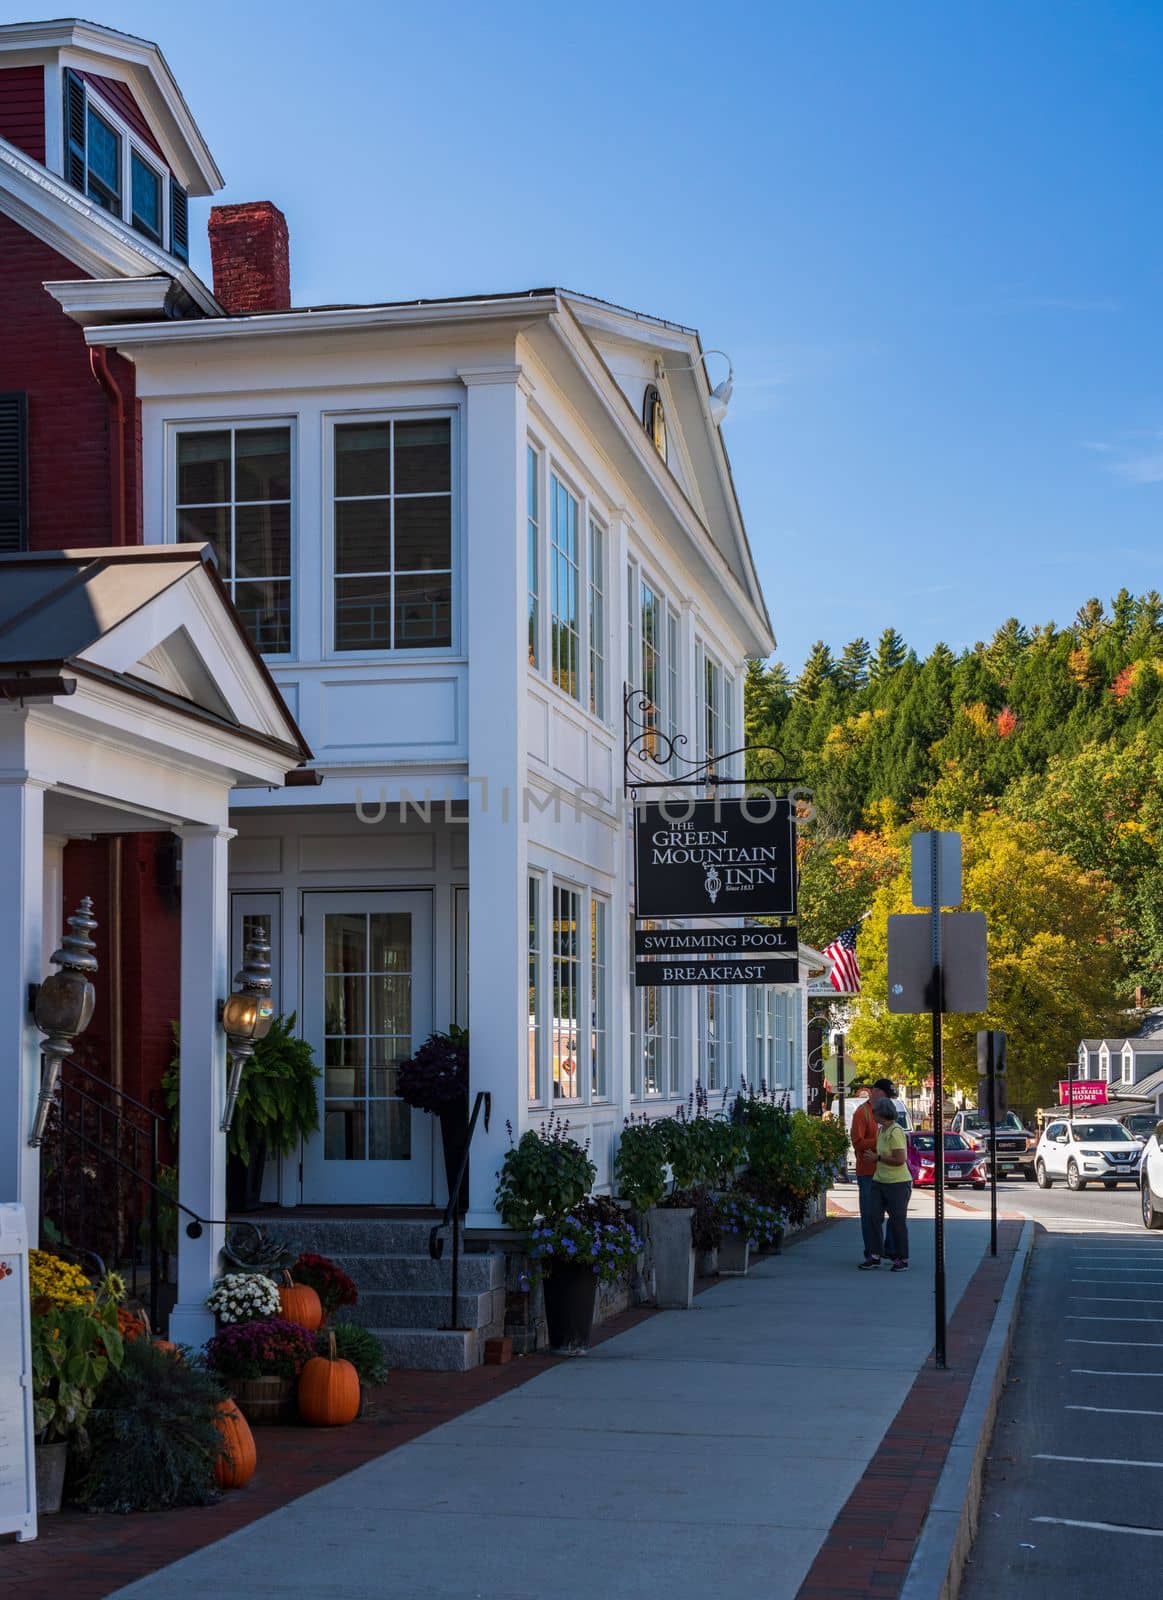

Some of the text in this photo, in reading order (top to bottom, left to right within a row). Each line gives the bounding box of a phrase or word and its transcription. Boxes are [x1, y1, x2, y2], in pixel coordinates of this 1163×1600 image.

[668, 822, 694, 831] THE
[652, 831, 728, 847] GREEN
[652, 847, 777, 865] MOUNTAIN
[725, 868, 777, 884] INN
[644, 934, 787, 949] SWIMMING POOL
[663, 966, 766, 981] BREAKFAST
